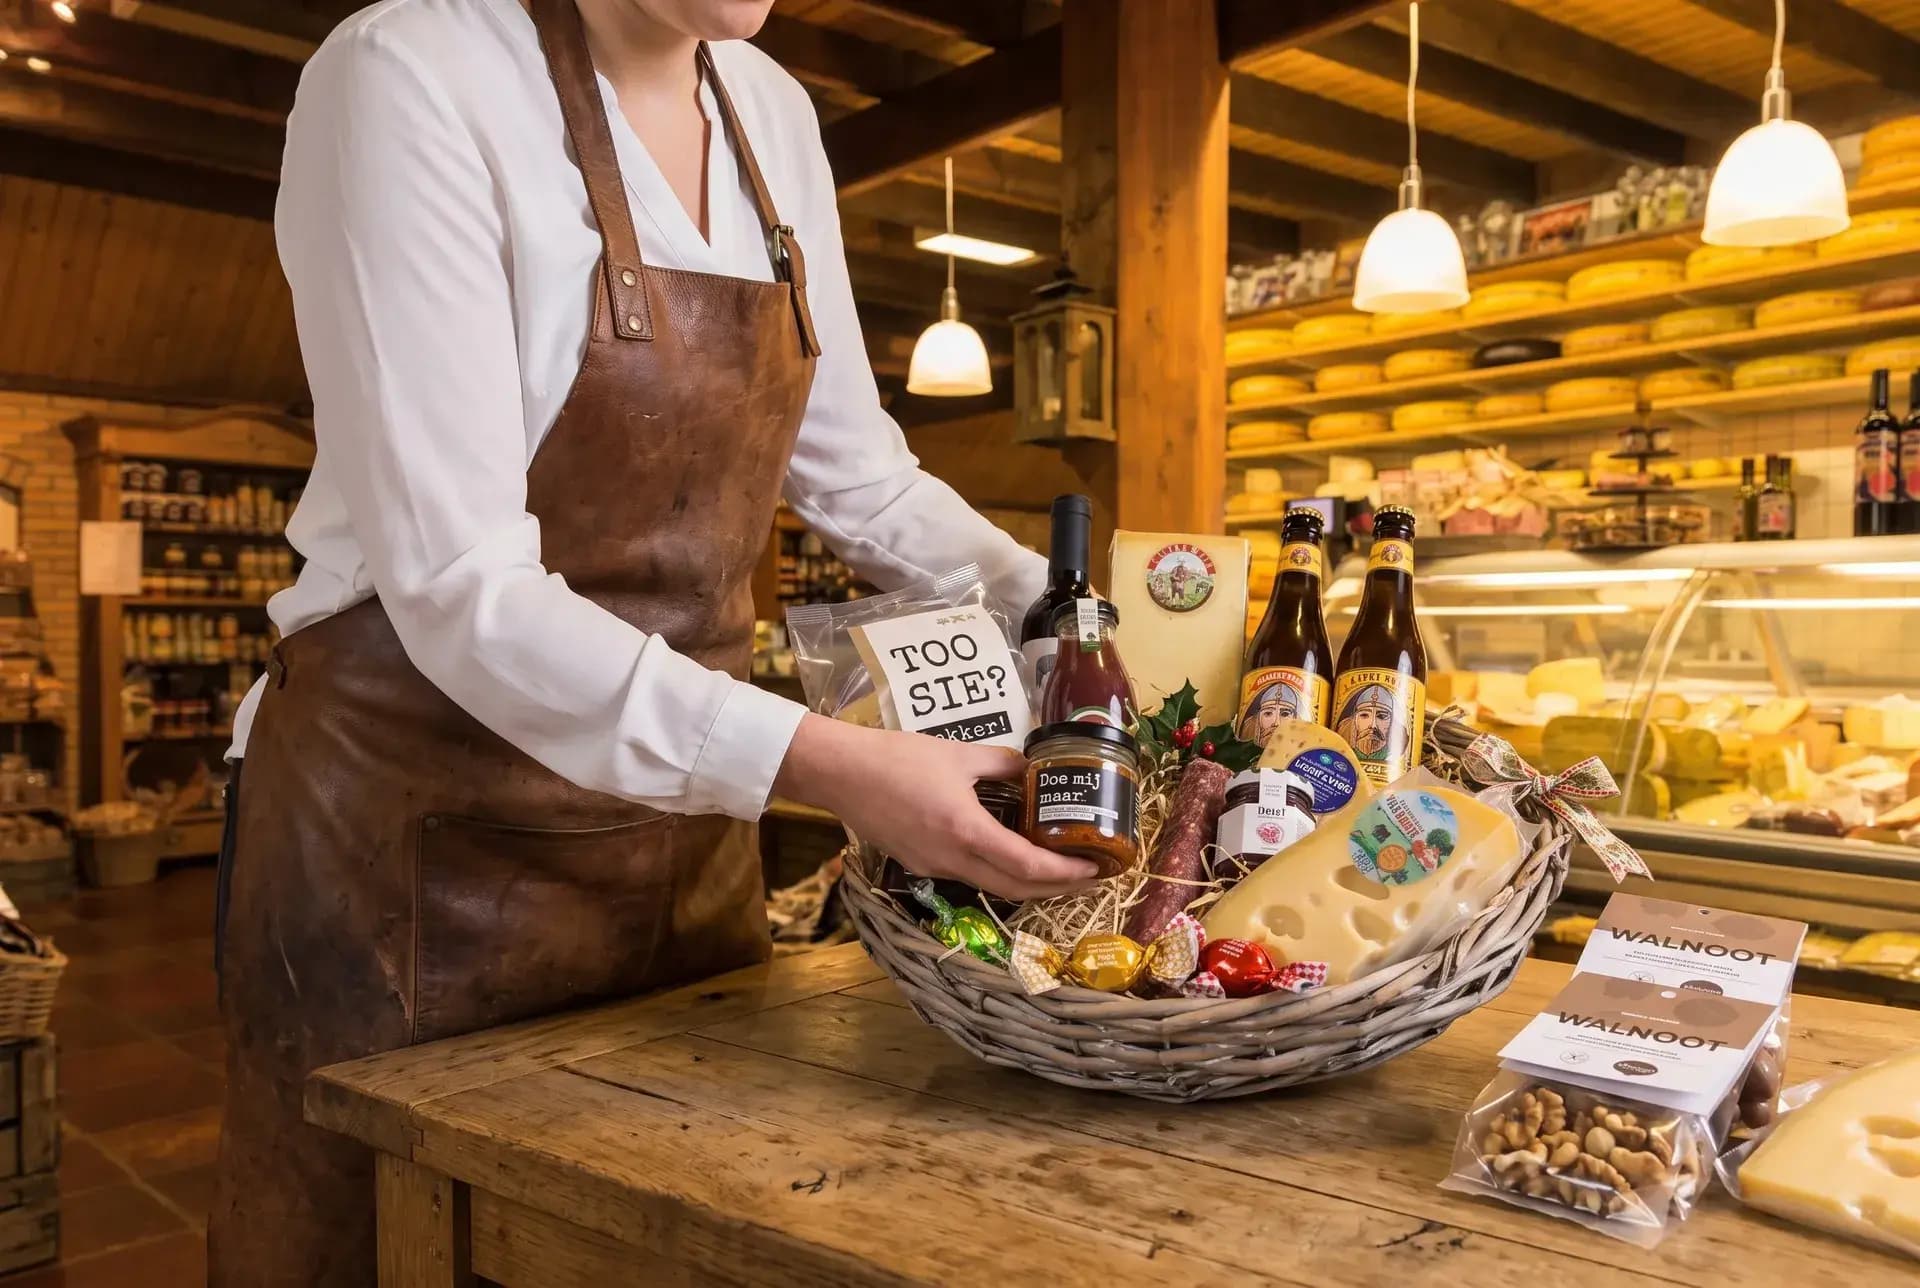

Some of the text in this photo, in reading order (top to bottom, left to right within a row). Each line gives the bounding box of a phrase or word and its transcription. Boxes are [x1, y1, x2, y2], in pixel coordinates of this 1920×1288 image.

[890, 634, 978, 673] TOO
[909, 665, 1006, 717] SIE?
[1039, 772, 1101, 790] Doe mij
[1611, 927, 1777, 965] WALNOOT
[1558, 1011, 1728, 1052] WALNOOT
